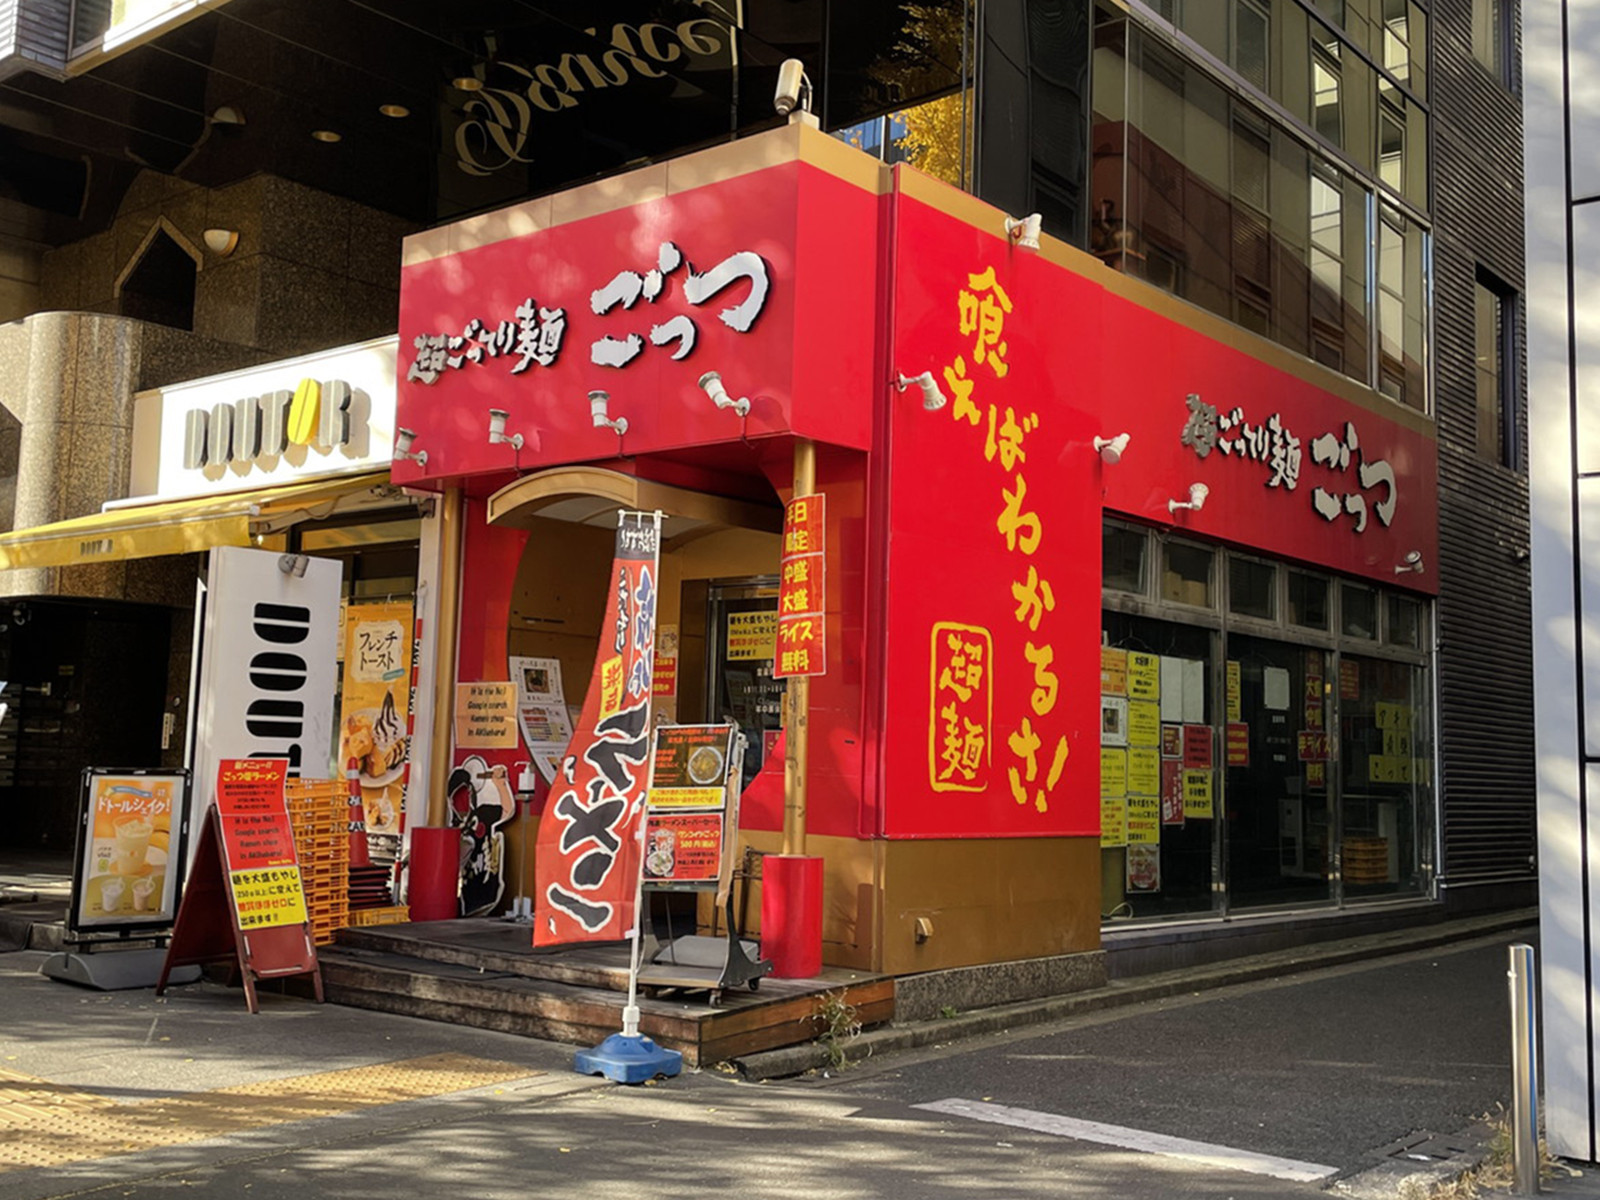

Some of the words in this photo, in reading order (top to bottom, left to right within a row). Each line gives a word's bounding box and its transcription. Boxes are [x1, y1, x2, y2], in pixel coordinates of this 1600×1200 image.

[590, 240, 771, 368] ごっつ
[183, 376, 353, 470] DOUTOR
[1311, 422, 1398, 533] ごっつ
[784, 559, 809, 585] 中盛
[783, 589, 809, 613] 大盛
[359, 630, 398, 652] フレンチ
[780, 620, 814, 643] ライス
[360, 651, 394, 672] トースト
[781, 648, 810, 673] 無料
